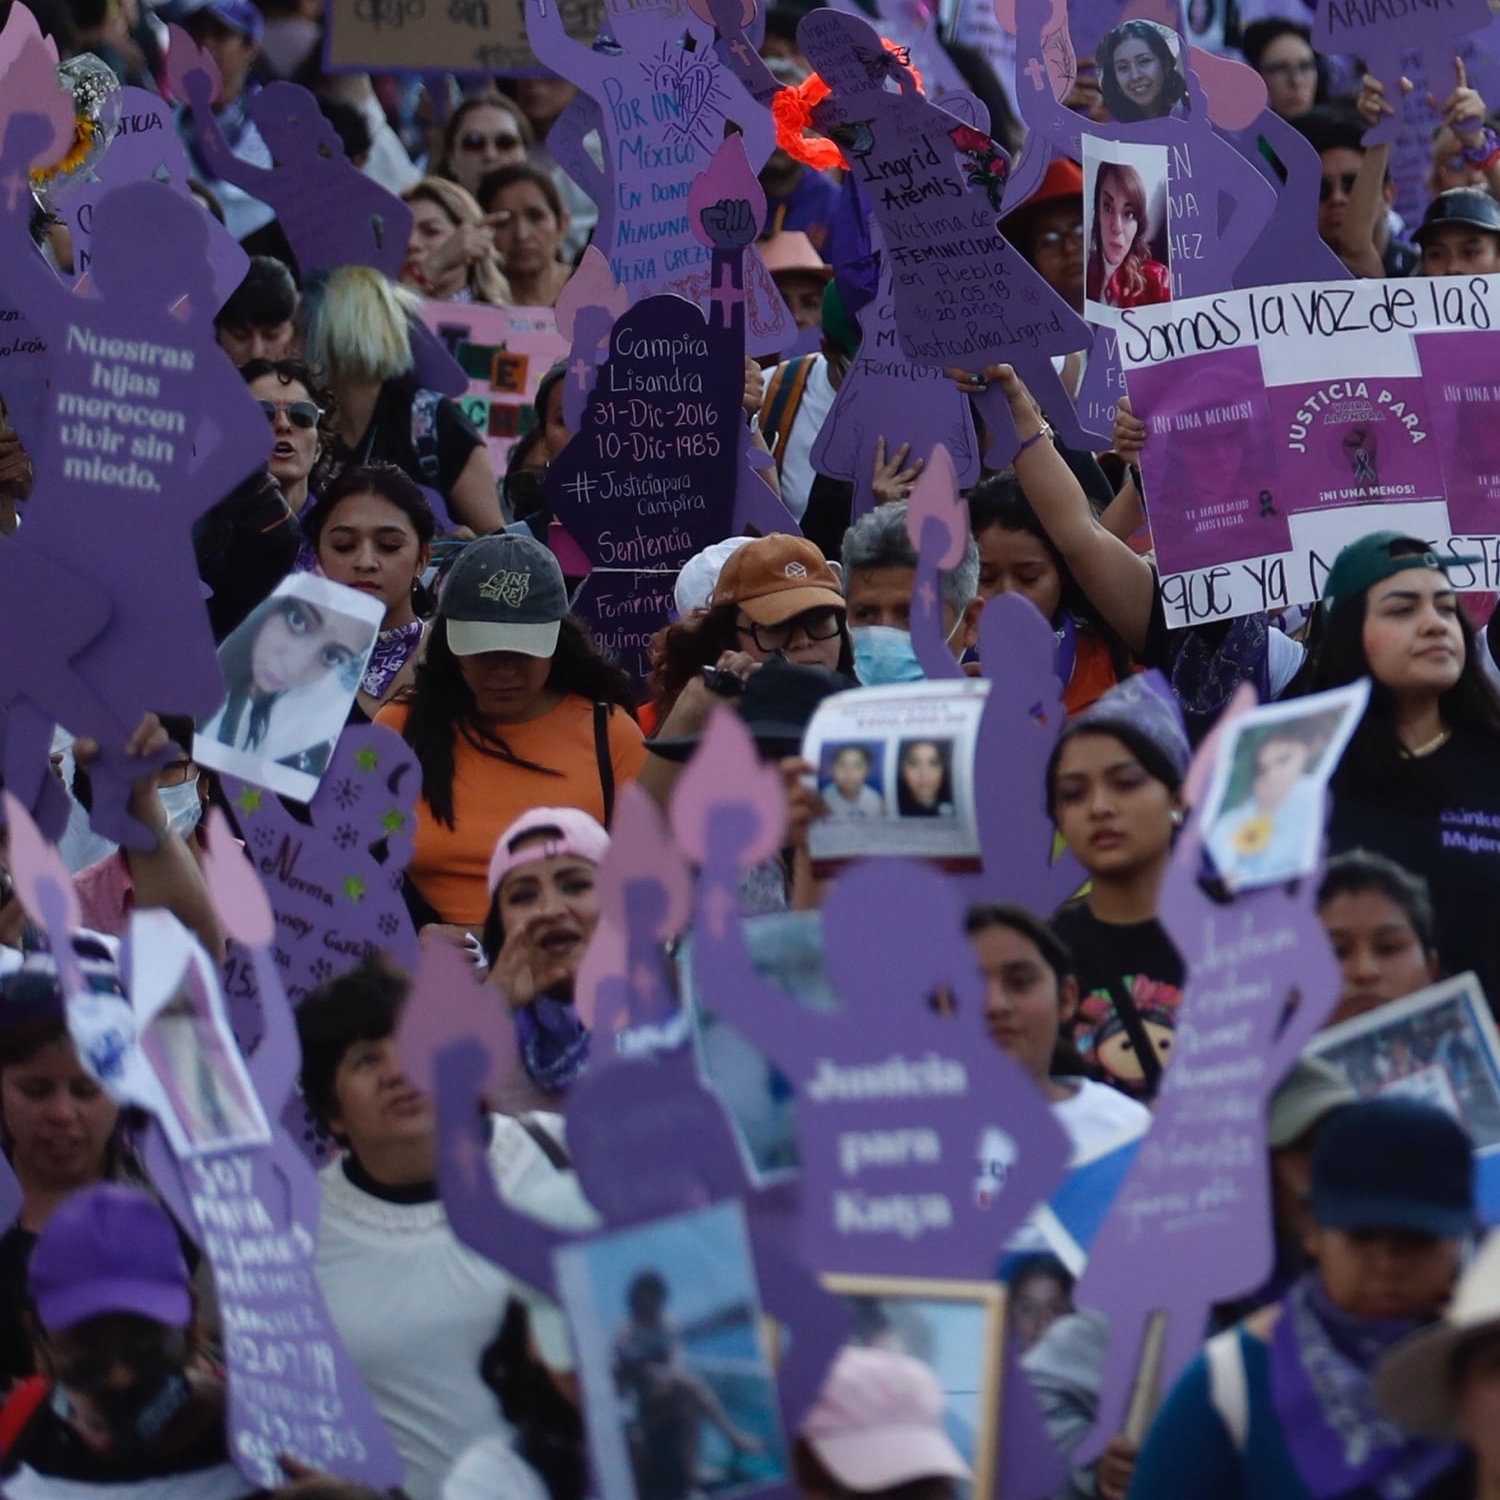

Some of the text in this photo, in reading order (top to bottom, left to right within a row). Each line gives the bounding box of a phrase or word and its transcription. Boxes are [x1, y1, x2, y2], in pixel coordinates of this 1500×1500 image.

[854, 134, 941, 183] Ingrid
[891, 236, 1005, 265] FEMINICIDIO
[937, 263, 1011, 287] Puebla
[66, 326, 194, 371] Nuestras
[616, 327, 709, 362] Campira
[610, 368, 703, 393] Lisandra
[1464, 385, 1489, 401] UNA
[58, 393, 185, 434] merecen
[594, 400, 718, 427] 31-Dic-2016
[1174, 407, 1201, 430] UNA
[1204, 401, 1254, 425] MENOS!
[1288, 381, 1426, 453] JUSTICIA PARA
[60, 422, 174, 463] vivir sin
[1340, 487, 1367, 499] UNA
[1369, 484, 1415, 497] MENOS!
[598, 527, 692, 564] Sentencia
